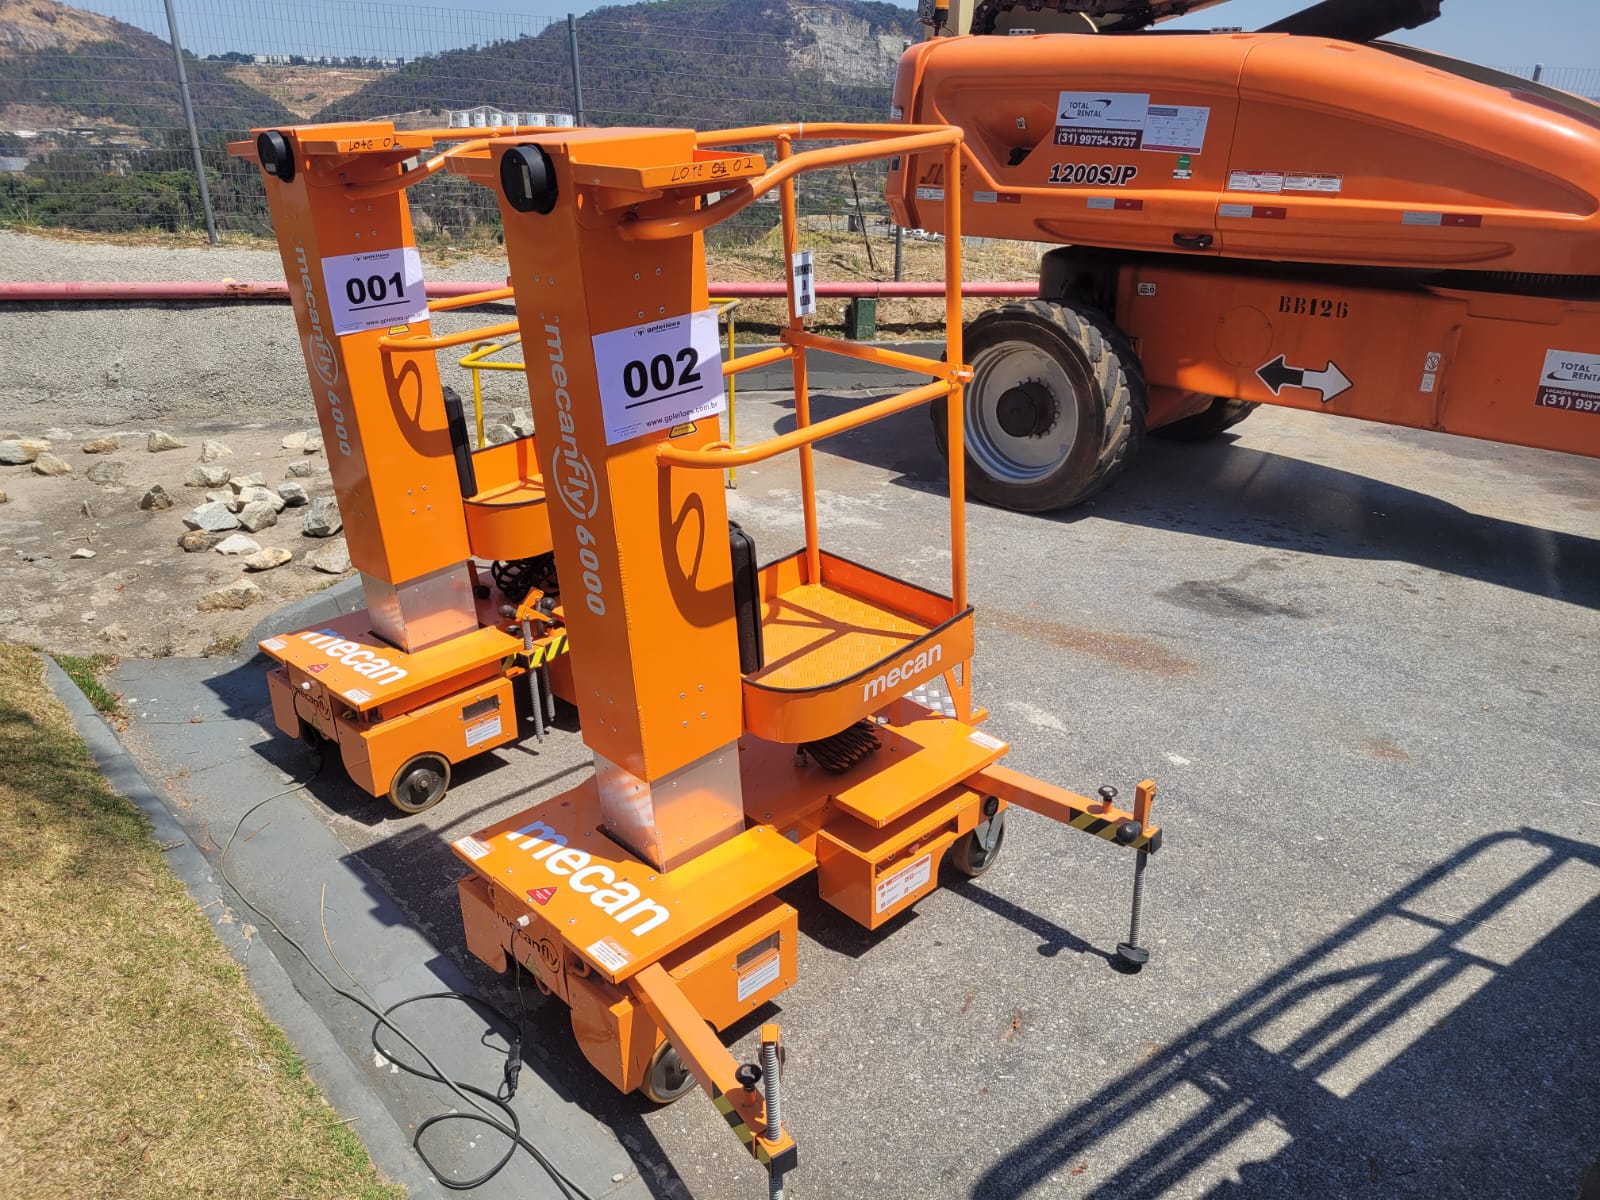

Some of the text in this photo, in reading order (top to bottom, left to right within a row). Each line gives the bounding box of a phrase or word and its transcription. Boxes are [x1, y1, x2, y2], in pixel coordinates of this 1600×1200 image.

[1069, 101, 1089, 110] TOTAL
[1077, 109, 1102, 118] RENTAL
[1057, 132, 1137, 148] (31) 99754-3737
[733, 157, 753, 171] 02
[1048, 163, 1138, 186] 1200SJP
[345, 271, 405, 305] 001
[1279, 295, 1349, 318] BB126
[295, 247, 352, 457] mecanfly 6000
[623, 347, 702, 398] 002
[1560, 362, 1591, 373] TOTAL
[1542, 393, 1572, 409] (31)
[645, 401, 719, 428] www.gpleiloes.com.br
[544, 324, 606, 616] mecanfly 6000
[300, 628, 408, 686] mecan
[863, 643, 942, 703] mecan
[506, 820, 670, 937] mecan
